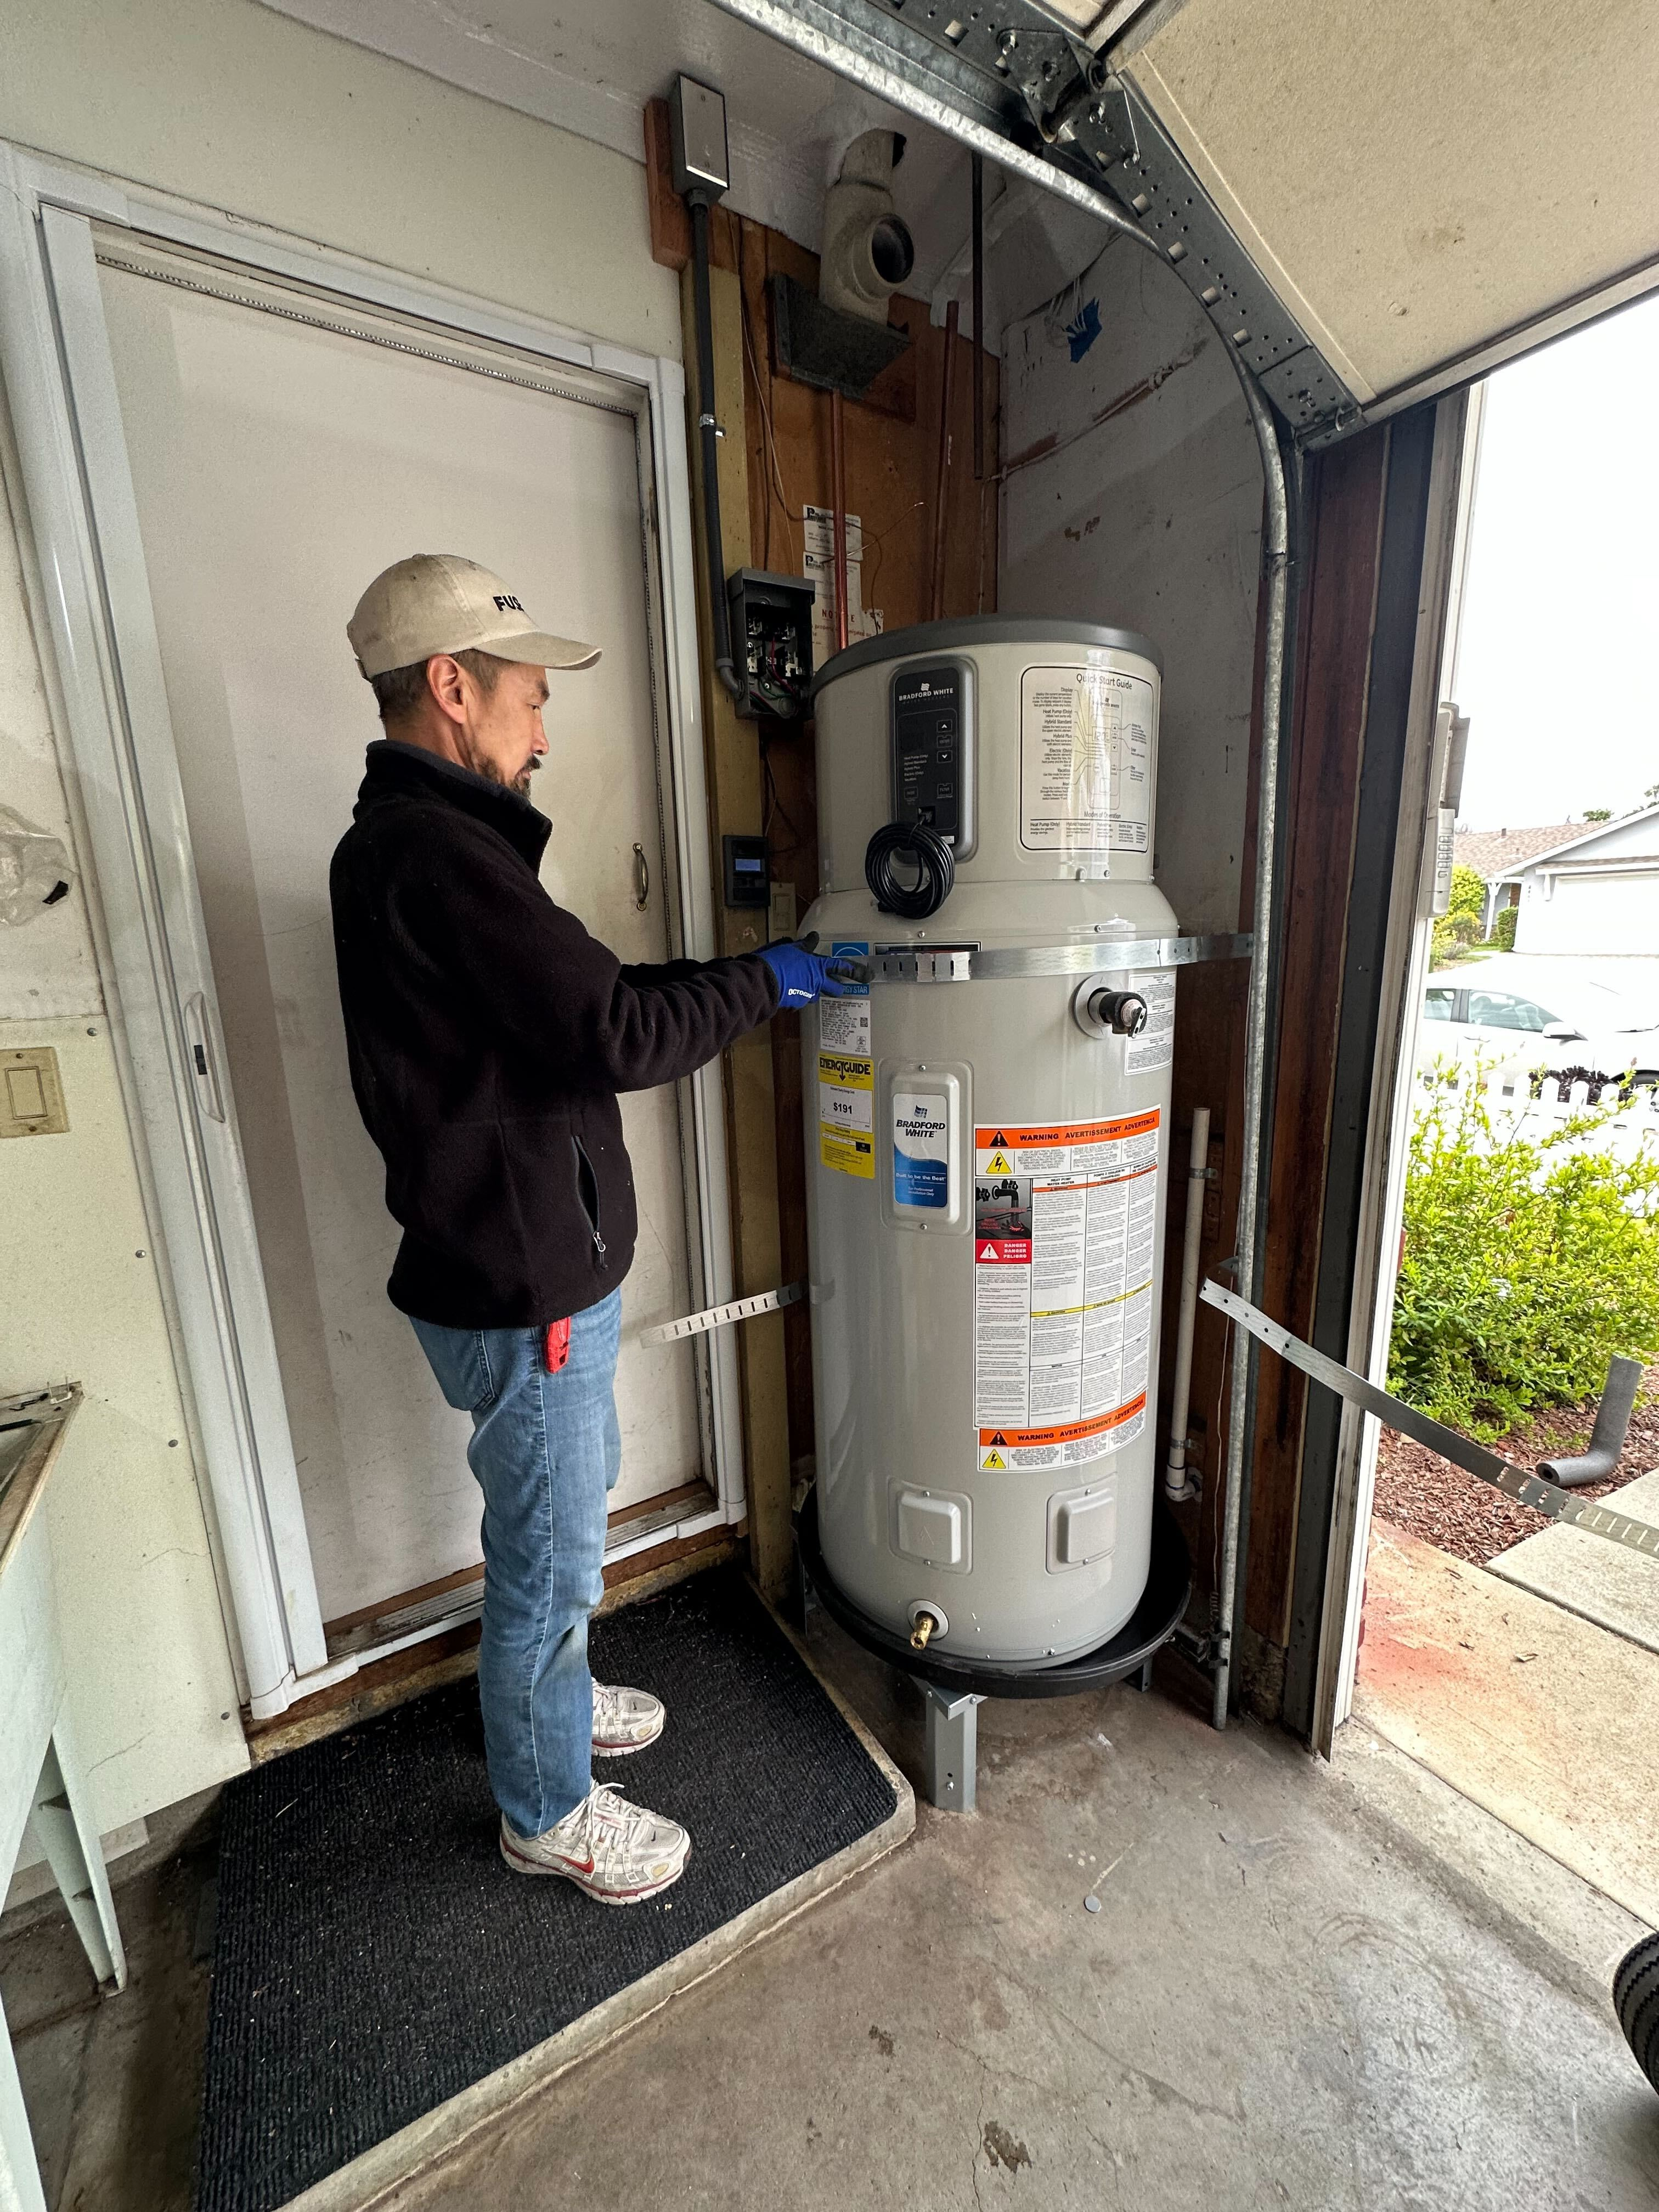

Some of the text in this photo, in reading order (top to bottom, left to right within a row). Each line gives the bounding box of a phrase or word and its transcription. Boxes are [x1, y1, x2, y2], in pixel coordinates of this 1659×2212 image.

[493, 595, 525, 612] FUS
[1076, 673, 1132, 690] Quick Start Guide
[899, 691, 932, 701] BRADFORD
[933, 687, 953, 696] WHITE
[820, 1057, 871, 1076] ENERGYGUIDE
[833, 1102, 852, 1114] $191
[896, 1119, 946, 1130] BRADFORD
[905, 1128, 934, 1137] WHITE
[1019, 1117, 1155, 1141] WARNING AVERTISSEMENT ADVERTENCIA
[1017, 1432, 1054, 1441] WARNING
[1059, 1418, 1112, 1437] AVERTISSEMENT
[1114, 1399, 1144, 1421] ADVERTENCIA
